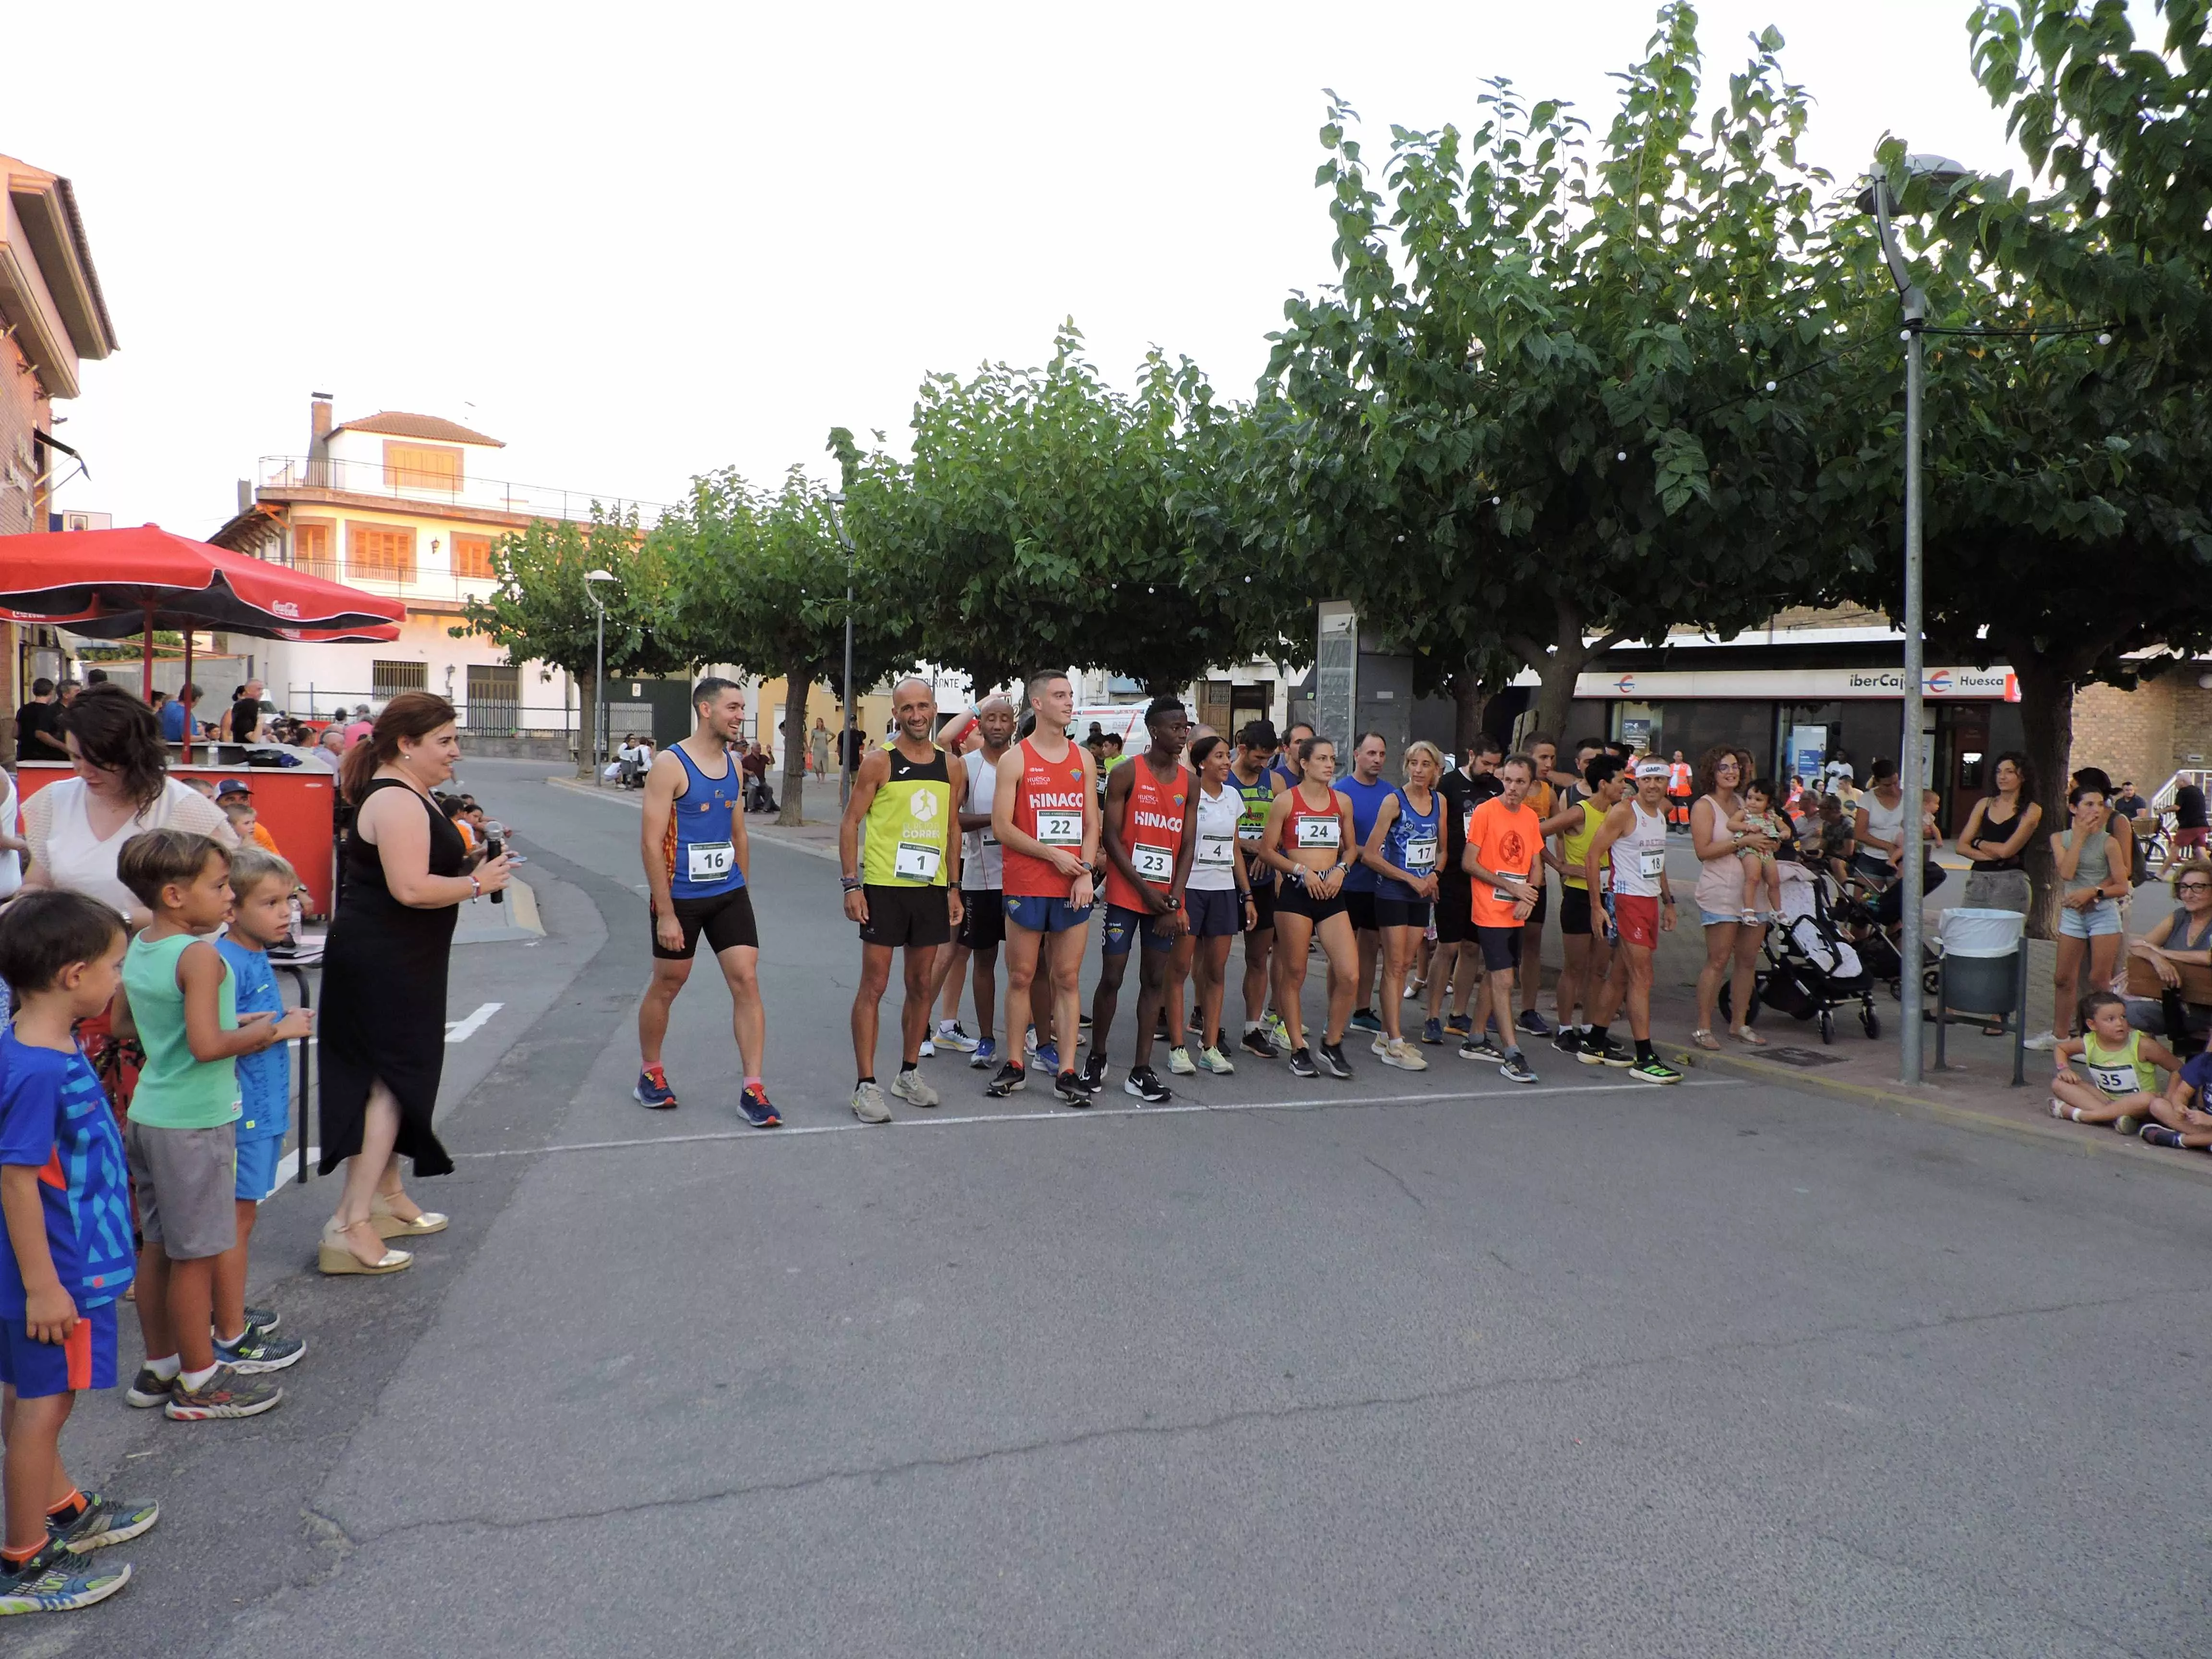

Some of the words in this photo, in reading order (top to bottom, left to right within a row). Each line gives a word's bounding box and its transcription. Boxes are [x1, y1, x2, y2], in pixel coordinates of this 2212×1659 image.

[1850, 674, 1906, 690] iberCaj
[1960, 675, 2004, 686] Huesca
[1029, 793, 1083, 809] HINACO
[1050, 820, 1070, 834] 22
[1134, 811, 1182, 833] HINACO
[1310, 825, 1328, 838] 24
[1213, 845, 1221, 857] 4
[1418, 847, 1431, 859] 17
[704, 853, 724, 869] 16
[916, 855, 926, 870] 1
[1143, 856, 1164, 871] 23
[1652, 857, 1660, 870] 18
[2100, 1073, 2122, 1086] 35
